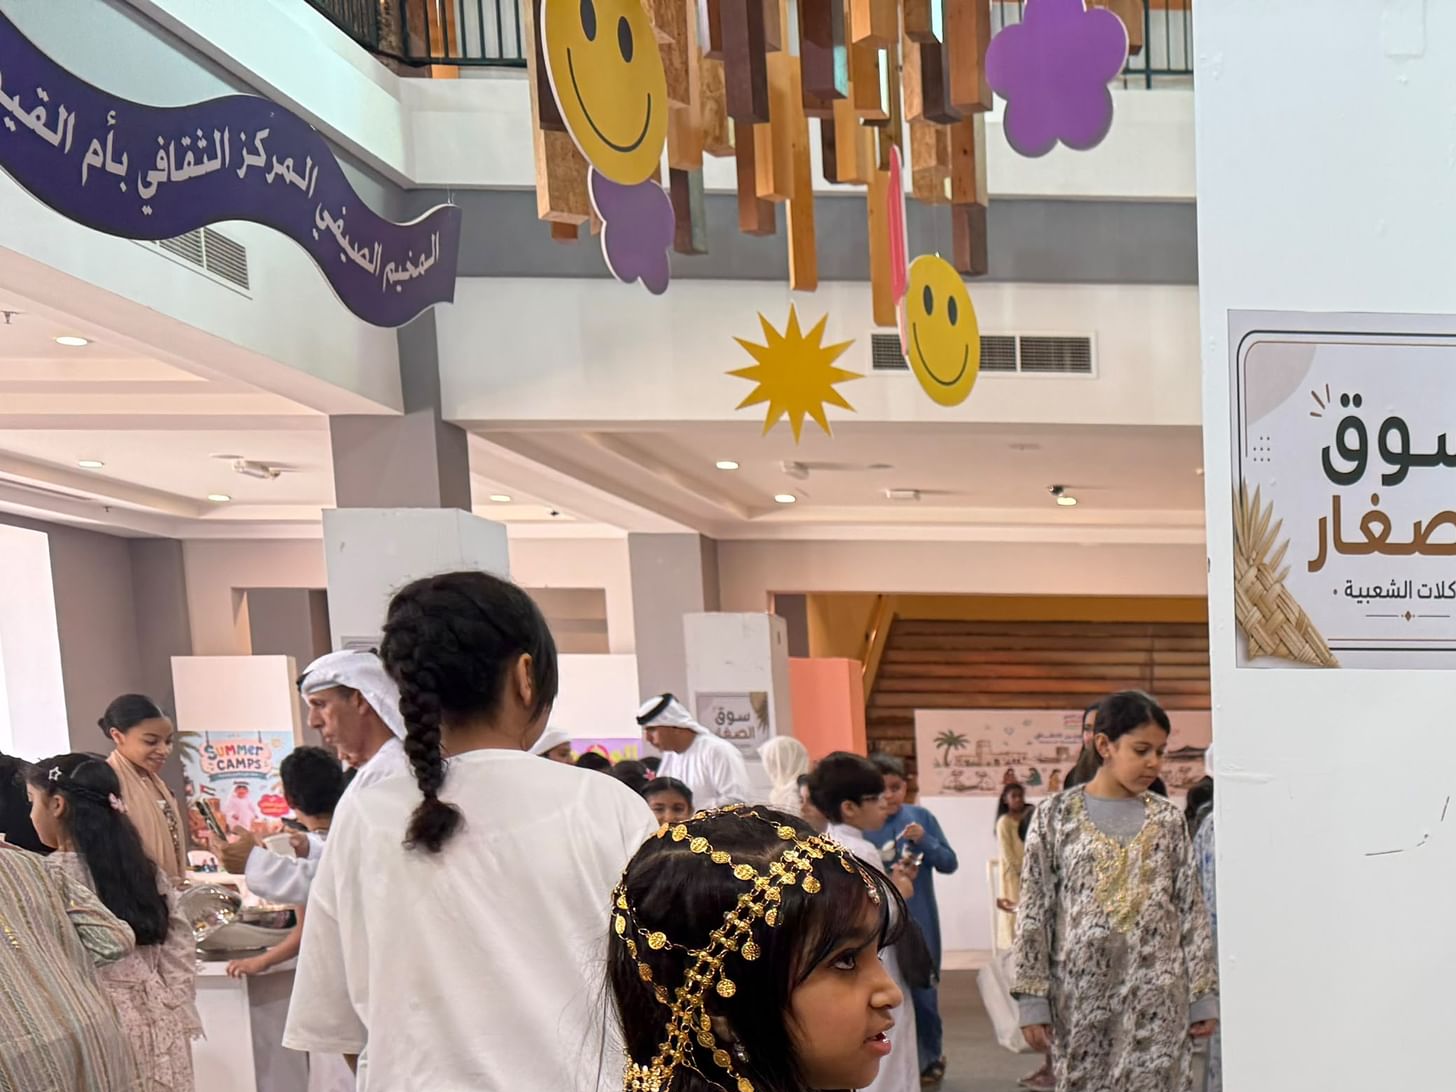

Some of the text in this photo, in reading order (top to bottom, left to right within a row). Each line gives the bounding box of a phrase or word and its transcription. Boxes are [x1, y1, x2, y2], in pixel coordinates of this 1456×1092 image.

[0, 71, 440, 293] المخيم الصيفي المركز الثقافي بأم القي
[1343, 578, 1413, 604] الشعبية
[715, 706, 751, 726] سوق
[216, 758, 262, 771] CAMPS
